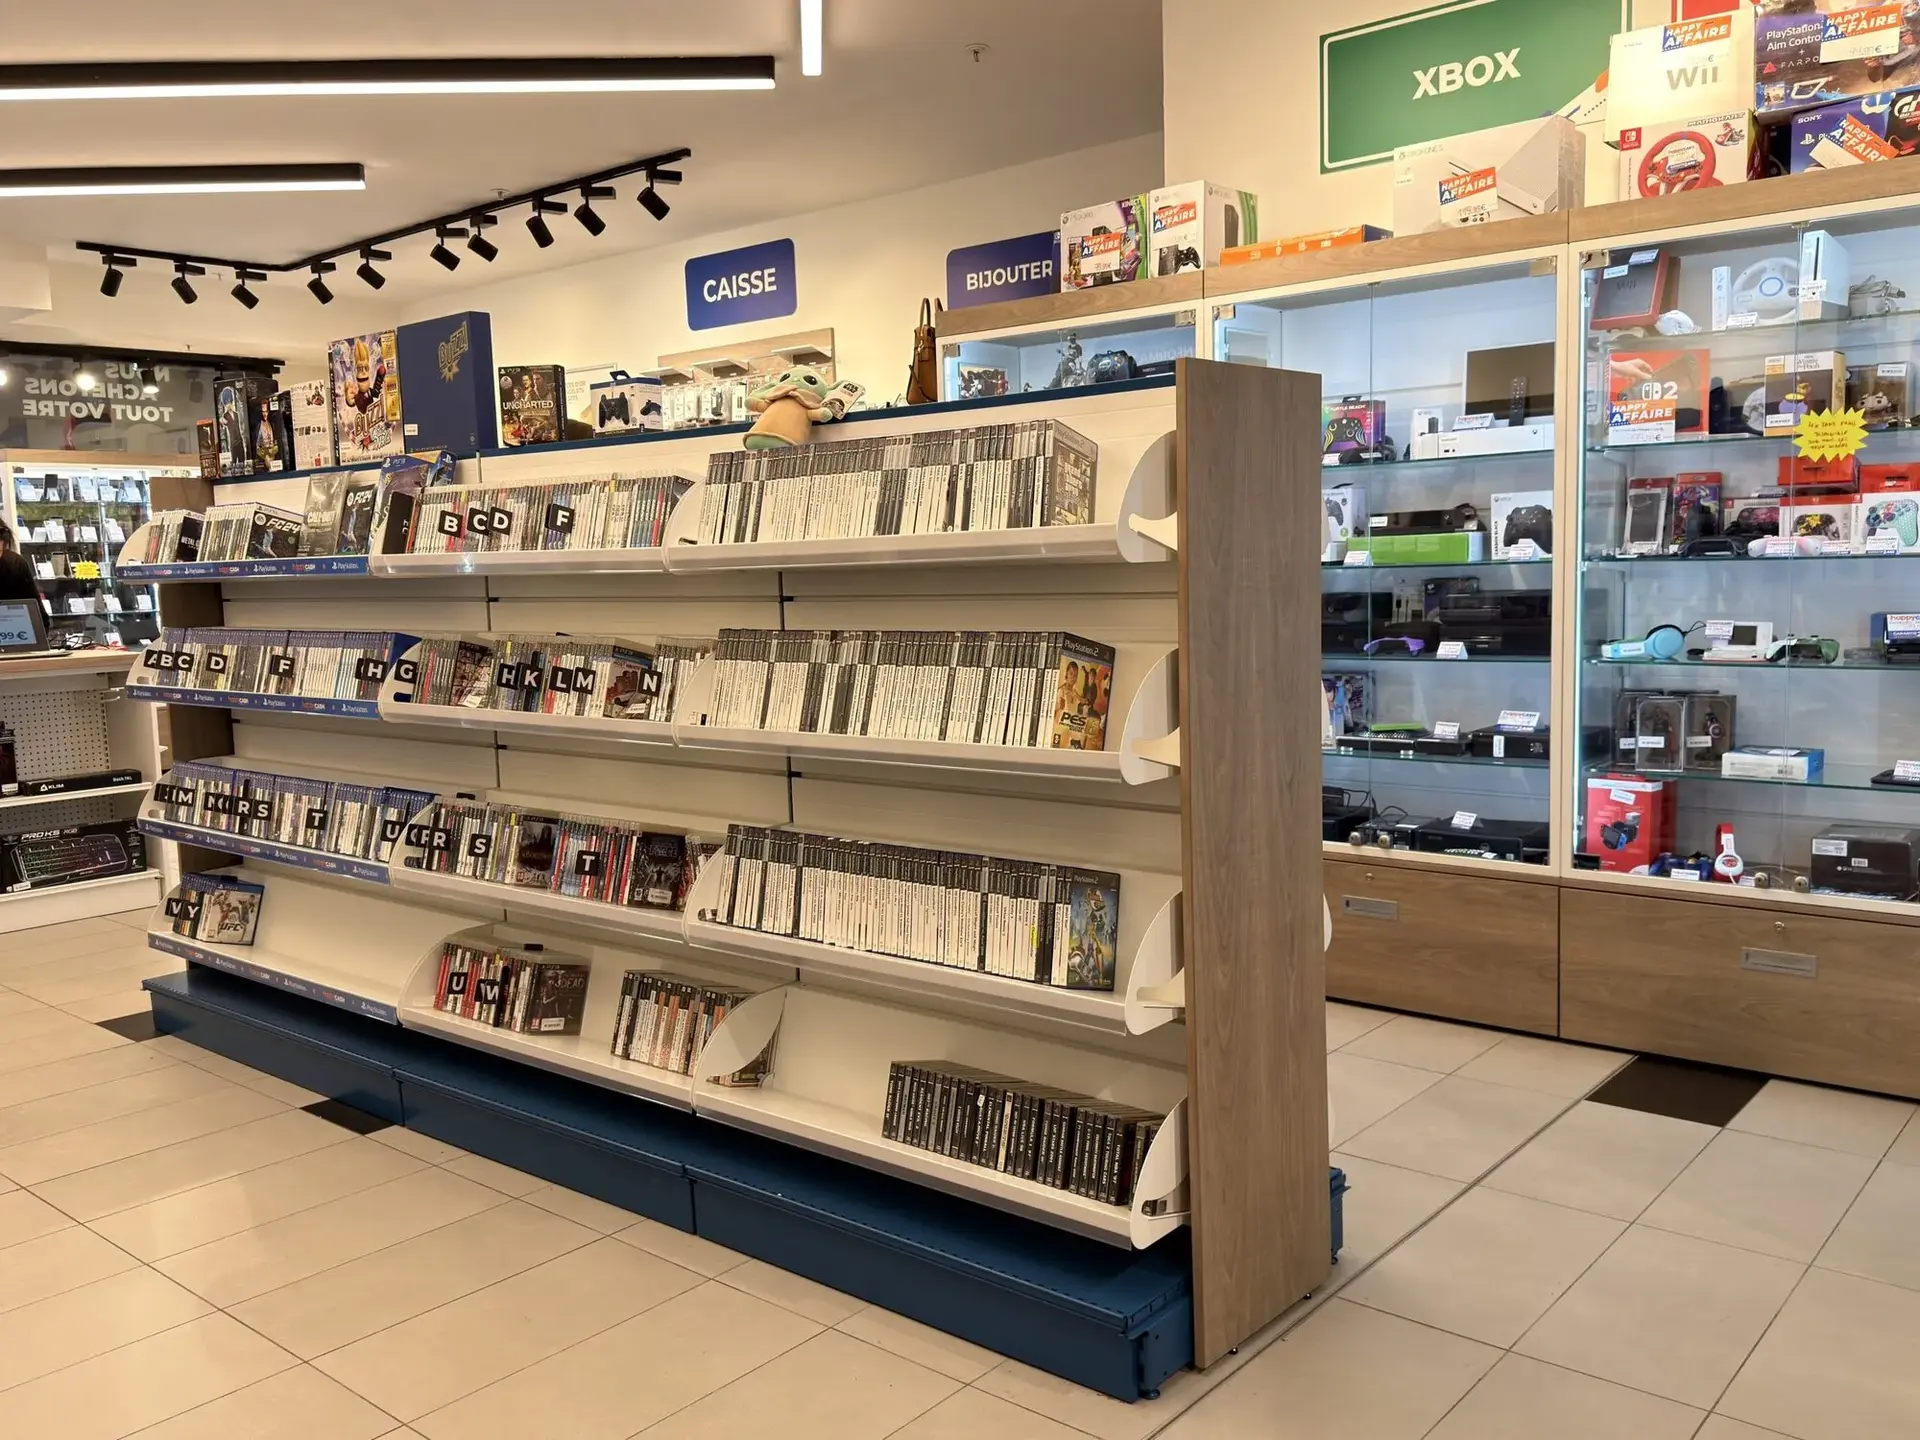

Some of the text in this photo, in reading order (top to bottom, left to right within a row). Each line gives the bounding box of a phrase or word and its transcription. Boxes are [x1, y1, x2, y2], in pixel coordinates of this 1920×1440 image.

[1824, 13, 1898, 38] AFFAIRE
[1826, 11, 1868, 26] HAPPY
[1665, 24, 1729, 48] AFFAIRE
[1666, 22, 1702, 37] HAPPY
[1767, 40, 1787, 51] Aim
[1412, 48, 1522, 100] XBOX
[1666, 66, 1719, 90] Wii
[1798, 114, 1823, 124] SONY
[1839, 119, 1874, 142] HAPPY
[1441, 174, 1471, 191] HAPPY
[1442, 176, 1494, 201] AFFAIRE
[1154, 209, 1196, 230] AFFAIRE
[1155, 206, 1179, 221] HAPPY
[1082, 239, 1121, 256] AFFAIRE
[1083, 236, 1105, 248] HAPPY
[702, 268, 777, 303] CAISSE
[502, 399, 554, 410] UNCHARTED
[1612, 402, 1648, 414] HAPPY
[1612, 407, 1673, 423] AFFAIRE
[444, 518, 458, 532] B
[472, 516, 486, 530] C
[493, 515, 509, 529] D
[557, 512, 570, 526] F
[1064, 639, 1093, 655] PlayStation
[160, 655, 172, 667] B
[178, 656, 190, 668] C
[210, 657, 223, 669] D
[279, 660, 290, 673] F
[368, 664, 382, 679] H
[400, 664, 414, 679] G
[502, 670, 515, 684] H
[525, 671, 539, 685] K
[556, 673, 567, 688] L
[576, 674, 592, 690] M
[643, 673, 658, 692] N
[1061, 711, 1087, 728] PES
[179, 790, 193, 804] M
[238, 801, 249, 814] R
[257, 804, 268, 817] S
[311, 813, 323, 826] T
[386, 826, 398, 839] U
[433, 832, 446, 846] R
[475, 839, 486, 853] S
[583, 856, 595, 871] T
[171, 902, 181, 914] V
[188, 906, 199, 918] Y
[220, 922, 243, 932] UFC
[452, 976, 464, 991] U
[486, 986, 499, 1001] W
